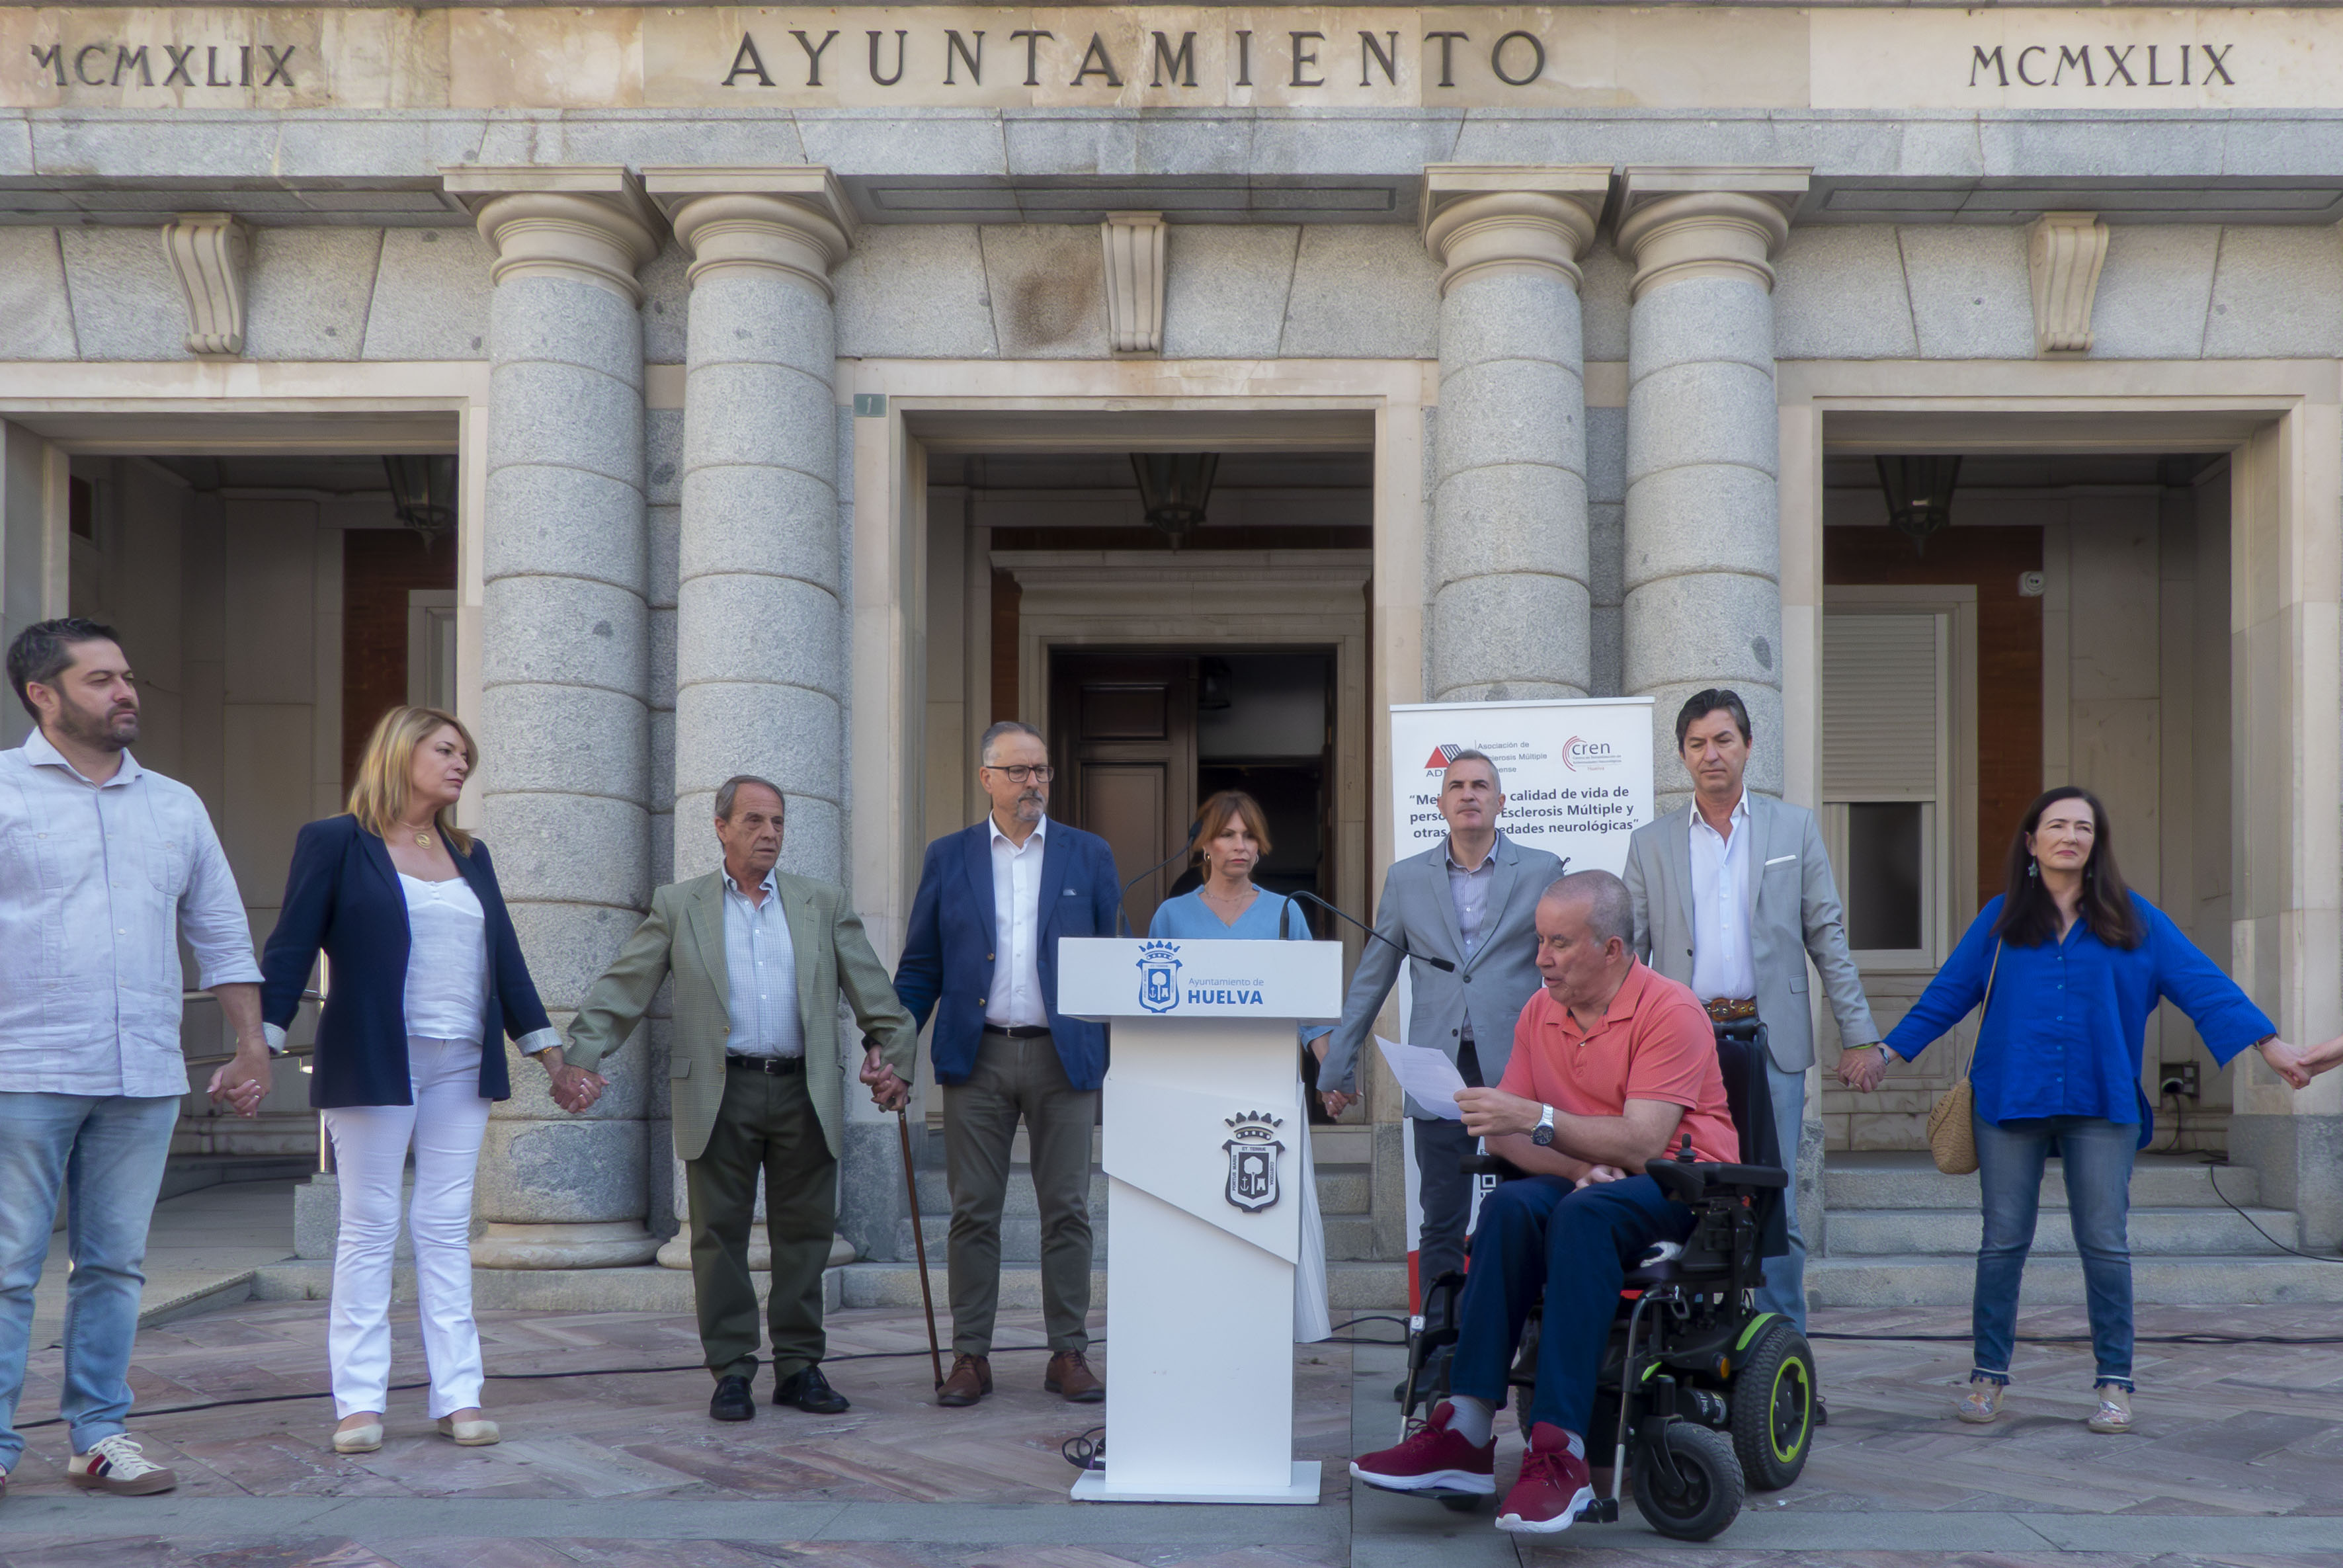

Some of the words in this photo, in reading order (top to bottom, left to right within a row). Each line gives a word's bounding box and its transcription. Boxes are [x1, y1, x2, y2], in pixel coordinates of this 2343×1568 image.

[31, 44, 296, 87] MCMXLIX
[721, 28, 1547, 87] AYUNTAMIENTO
[1968, 44, 2235, 87] MCMXLIX
[1518, 752, 1547, 761] Múltiple
[1572, 743, 1610, 755] cren
[1510, 788, 1557, 802] calidad
[1561, 788, 1577, 800] de
[1581, 786, 1609, 799] vida
[1613, 786, 1629, 798] de
[1410, 812, 1446, 825] perso
[1501, 805, 1563, 818] Esclerosis
[1567, 802, 1622, 817] Múltiple
[1626, 805, 1634, 816] y
[1413, 827, 1447, 838] otras
[1500, 823, 1544, 834] edades
[1549, 819, 1639, 834] neurológicas”
[1188, 977, 1251, 987] Ayuntamiento
[1188, 989, 1263, 1005] HUELVA
